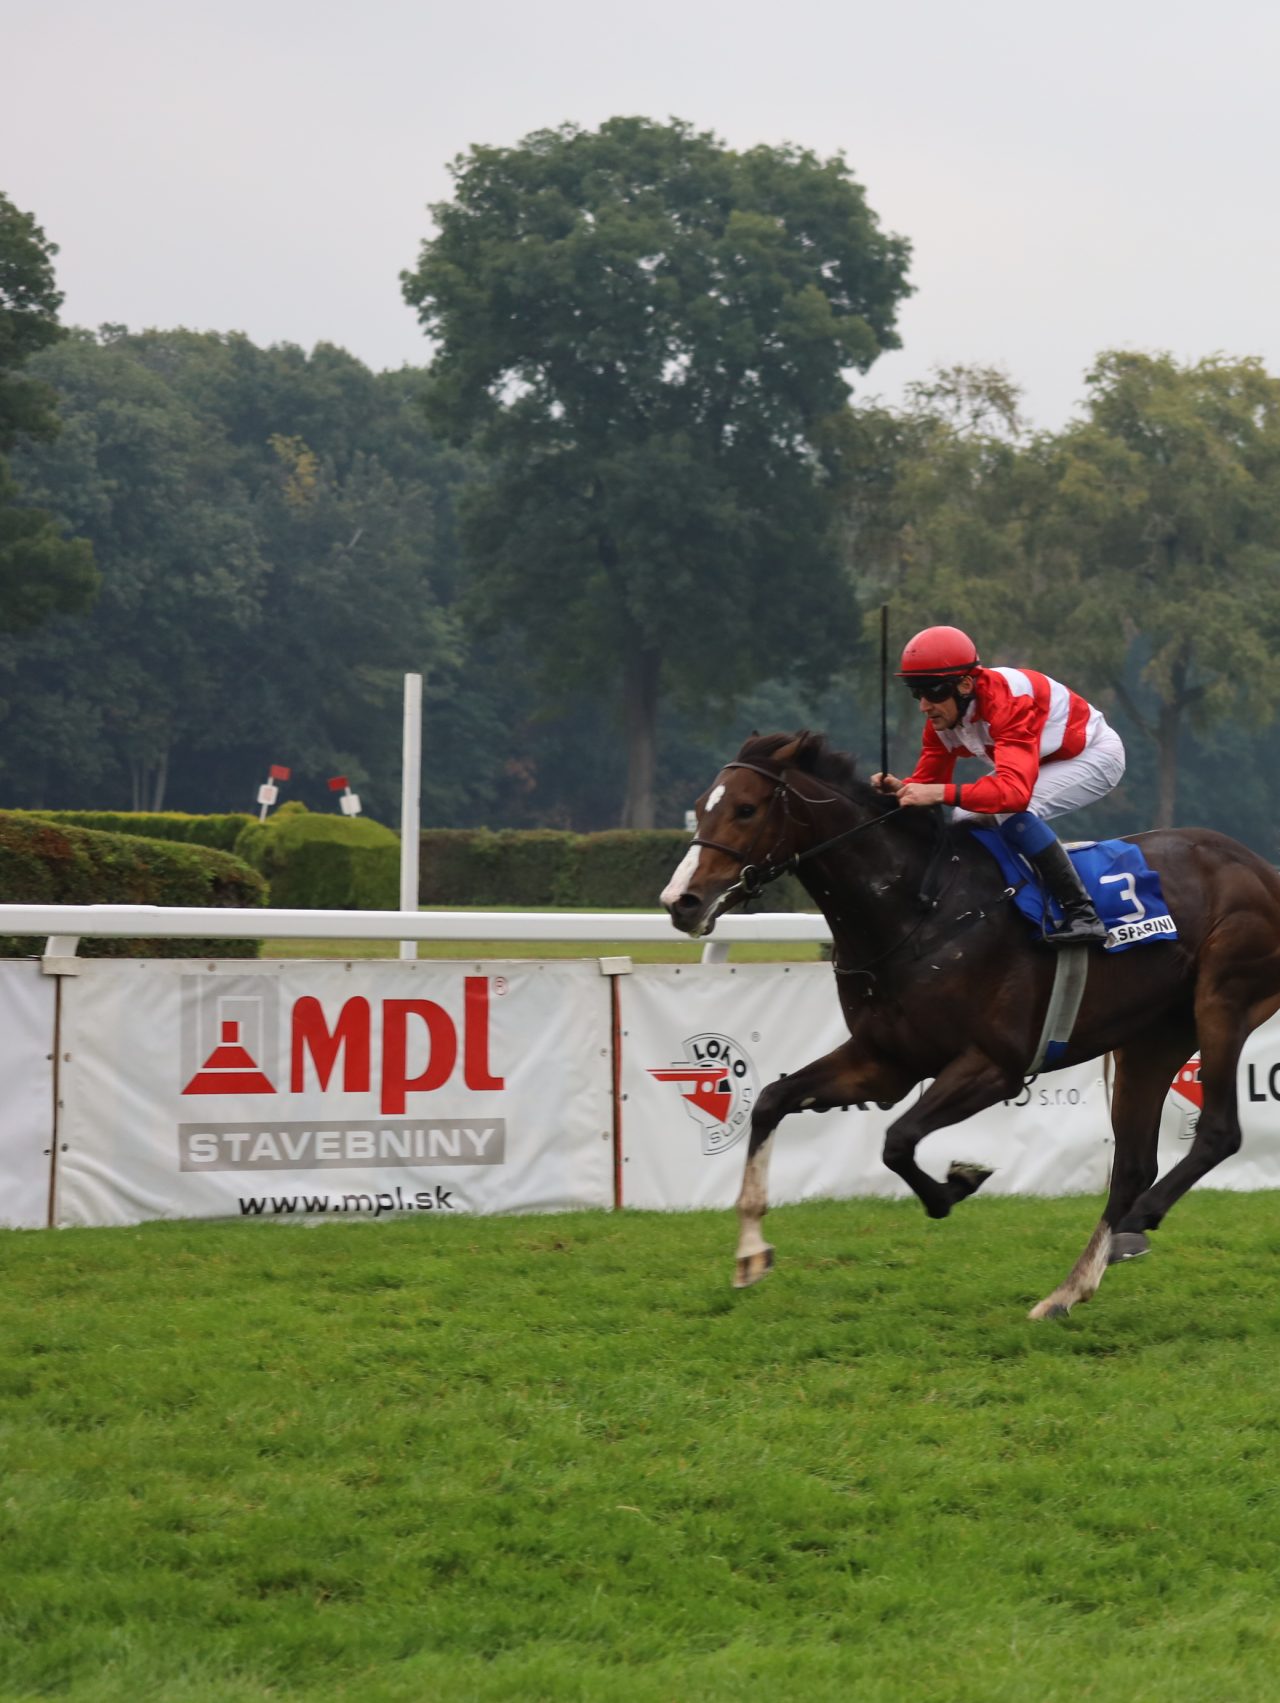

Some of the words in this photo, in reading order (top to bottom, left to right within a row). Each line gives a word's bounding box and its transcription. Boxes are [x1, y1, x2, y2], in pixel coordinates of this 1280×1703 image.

[1100, 872, 1145, 923] 3
[1112, 918, 1173, 943] SPARINI
[1039, 1087, 1086, 1106] s.r.o.
[188, 1128, 497, 1163] STAVEBNINY
[239, 1185, 454, 1217] www.mpl.sk
